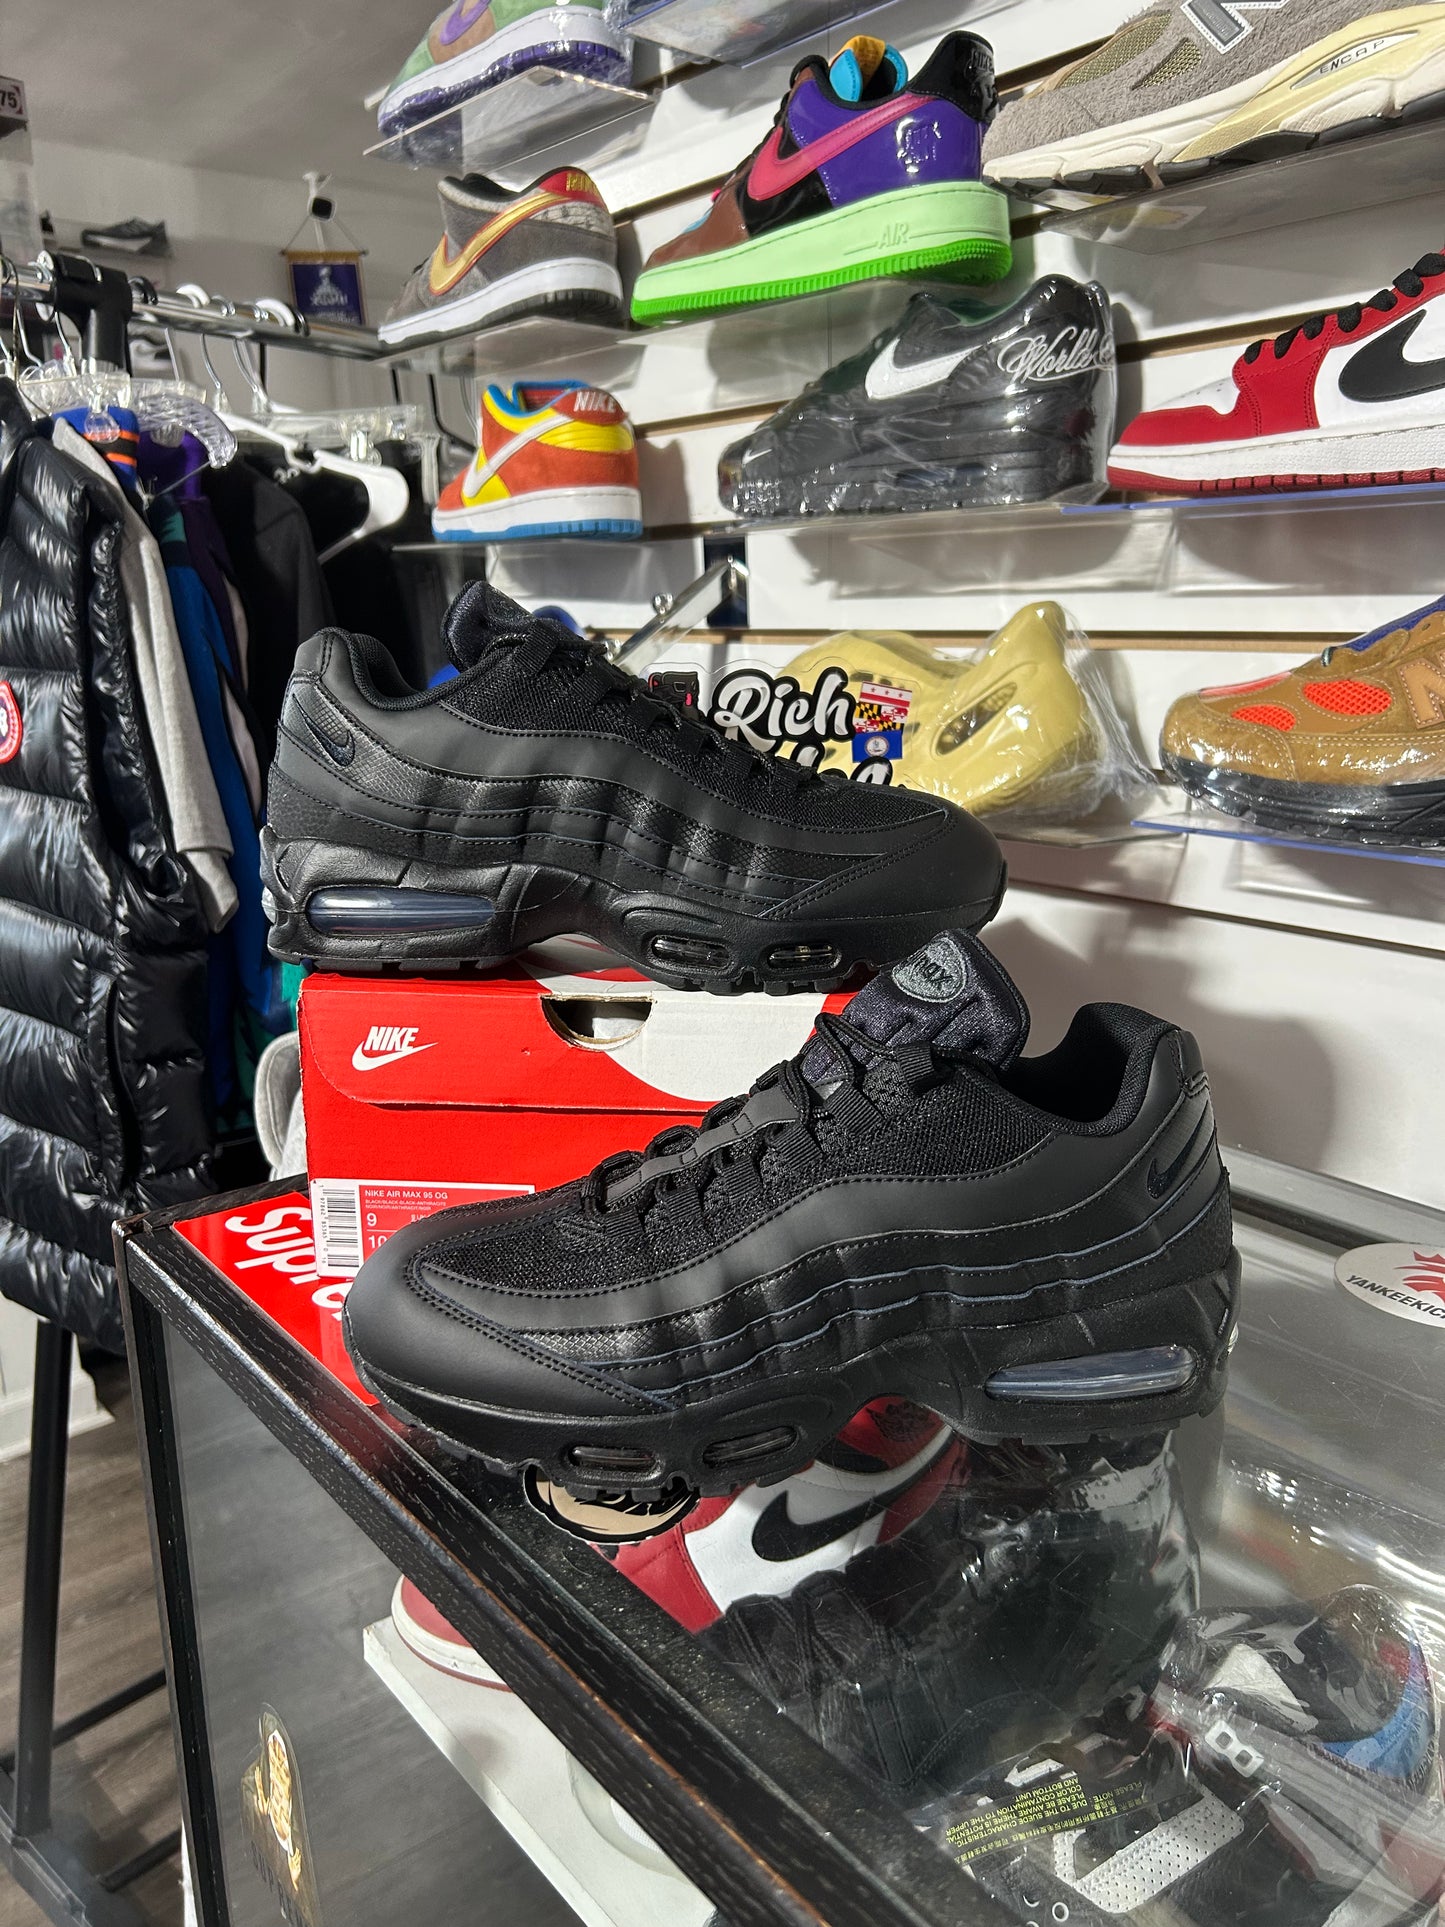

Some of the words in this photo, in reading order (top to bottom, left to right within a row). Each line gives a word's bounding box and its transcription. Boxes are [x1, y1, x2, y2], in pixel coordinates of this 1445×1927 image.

[1320, 39, 1385, 75] ENCAP
[879, 222, 910, 249] AIR
[573, 391, 617, 413] NIKE
[711, 669, 852, 755] Rich
[363, 1025, 420, 1051] NIKE
[364, 1189, 385, 1198] NIKE
[386, 1190, 401, 1198] AIR
[402, 1190, 422, 1199] MAX
[423, 1191, 433, 1199] 95
[434, 1191, 448, 1200] OG
[366, 1212, 377, 1227] 9
[1346, 1274, 1445, 1319] YANKEEKIC
[1063, 1777, 1079, 1786] AND
[1031, 1782, 1063, 1795] BOTTOM
[1056, 1784, 1082, 1797] COLOR
[1114, 1781, 1143, 1796] PLEASE
[996, 1791, 1056, 1816] CONTAMINATION
[1056, 1791, 1086, 1806] PLEASE
[1092, 1791, 1114, 1803] NOTE
[1017, 1804, 1044, 1817] AWARE
[1046, 1801, 1056, 1809] BE
[1059, 1804, 1071, 1813] TO
[1071, 1799, 1088, 1810] DUE
[984, 1811, 996, 1820] TO
[992, 1811, 1017, 1825] THERE
[1018, 1812, 1043, 1825] SUEDE
[1043, 1808, 1060, 1818] THE
[969, 1815, 984, 1826] THE
[984, 1818, 992, 1828] IS
[945, 1824, 984, 1844] POTENTIAL
[946, 1821, 970, 1836] UPPER
